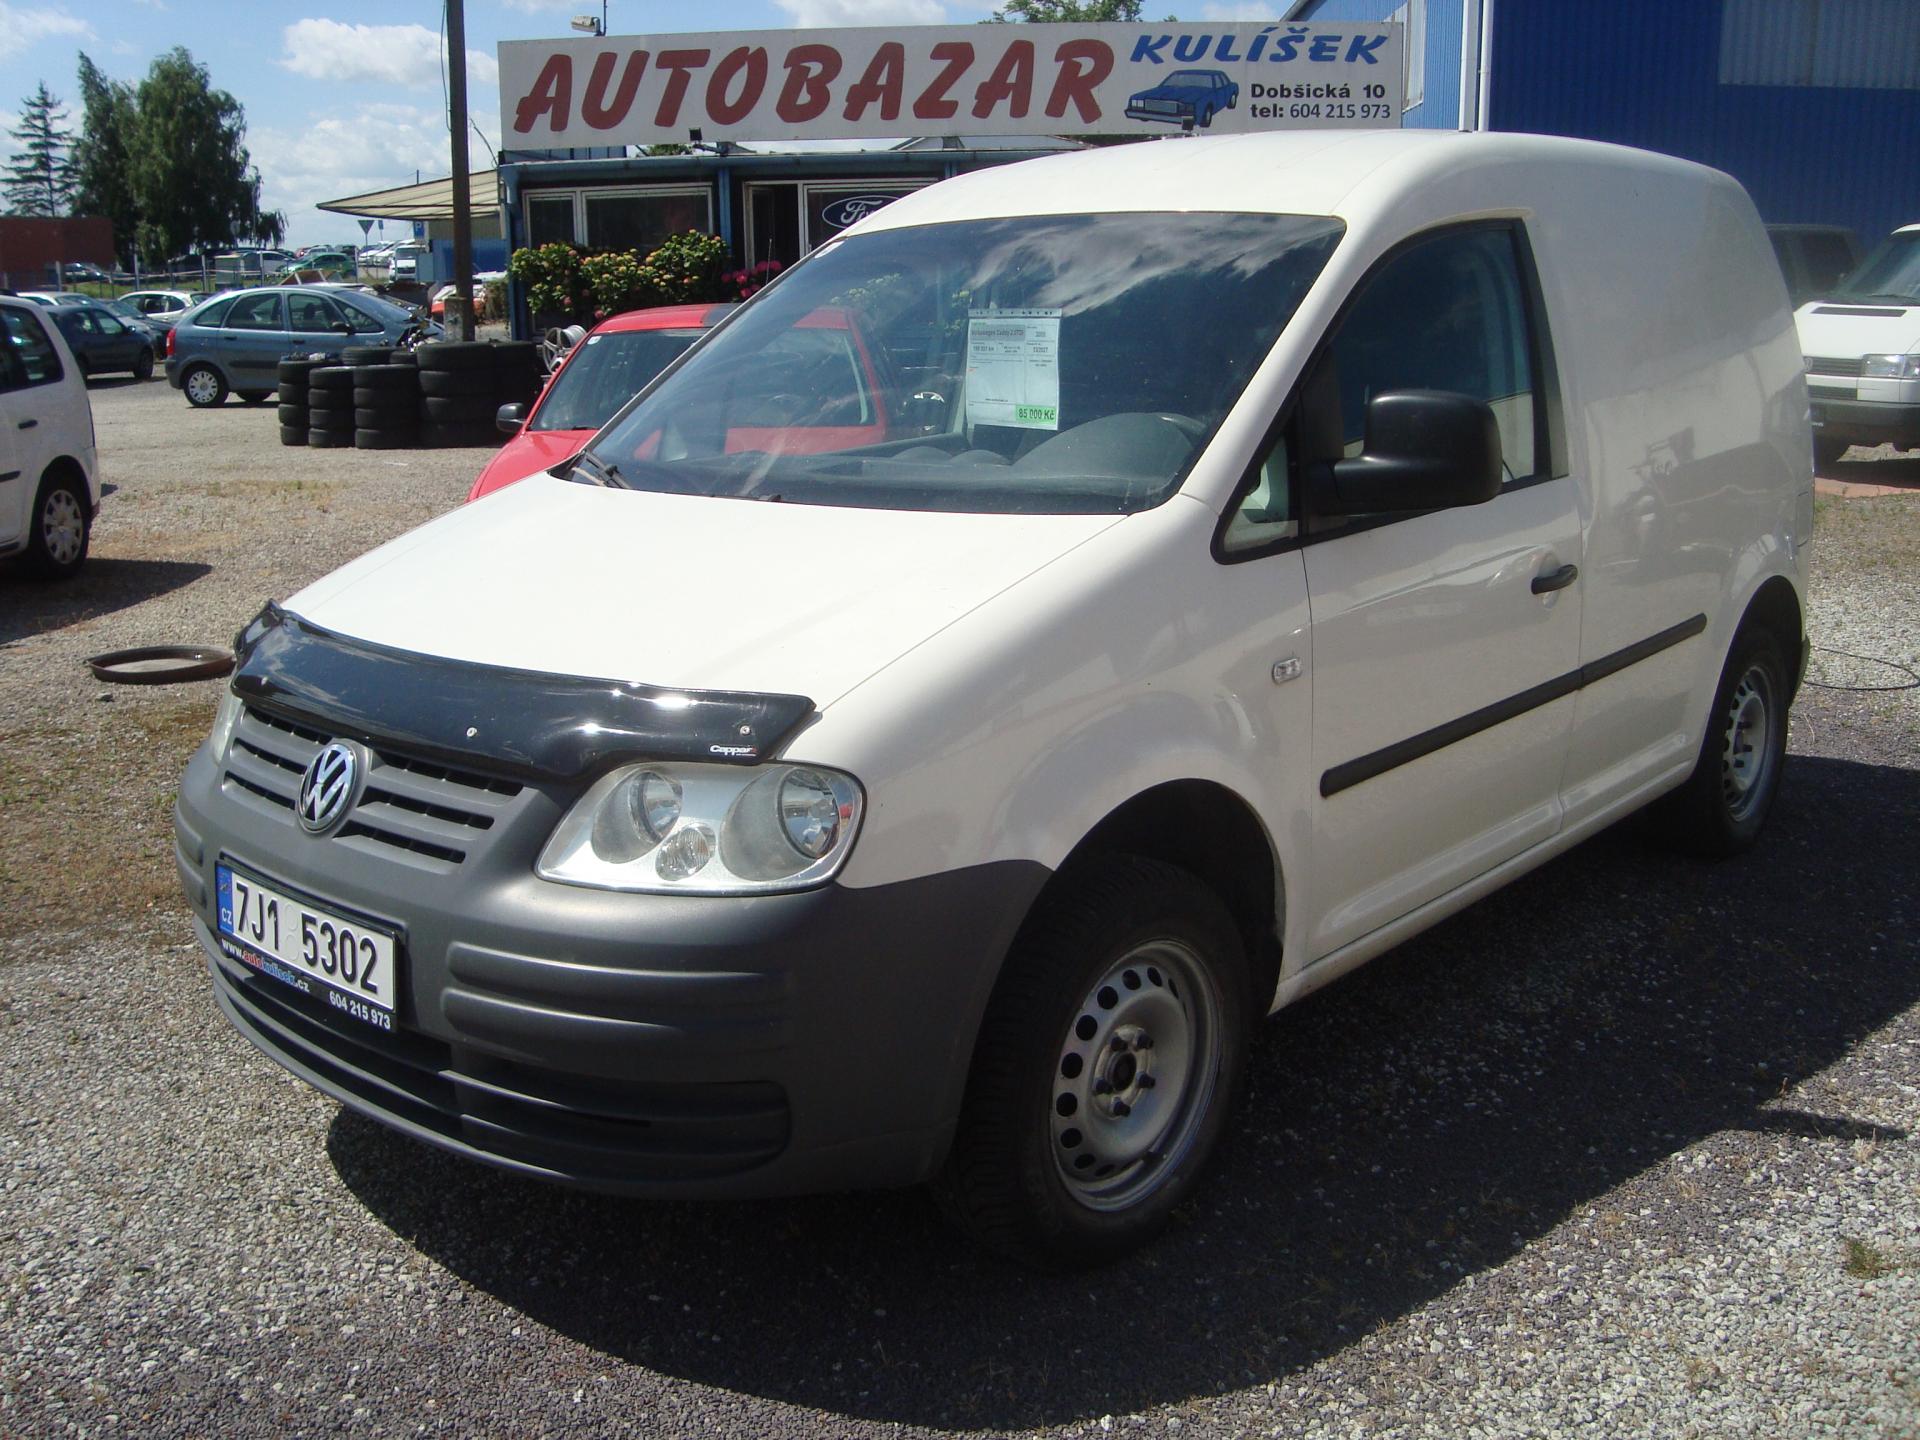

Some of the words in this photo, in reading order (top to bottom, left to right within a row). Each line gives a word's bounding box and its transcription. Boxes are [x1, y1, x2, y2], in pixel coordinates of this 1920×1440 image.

[1130, 26, 1388, 64] KULÍŠEK
[513, 38, 1114, 133] AUTOBAZAR
[1251, 83, 1350, 99] Dobšická
[1363, 84, 1386, 99] 10
[1250, 103, 1284, 118] tel:
[1290, 104, 1320, 119] 604
[1325, 104, 1355, 119] 215
[1360, 103, 1391, 119] 973
[1019, 408, 1028, 418] 85
[1029, 409, 1043, 420] 000
[1044, 410, 1055, 420] Kč
[221, 907, 233, 925] CZ
[235, 881, 280, 951] 7J1
[301, 911, 379, 995] 5302
[329, 990, 348, 1011] 604
[350, 998, 369, 1021] 215
[371, 1008, 391, 1030] 973
